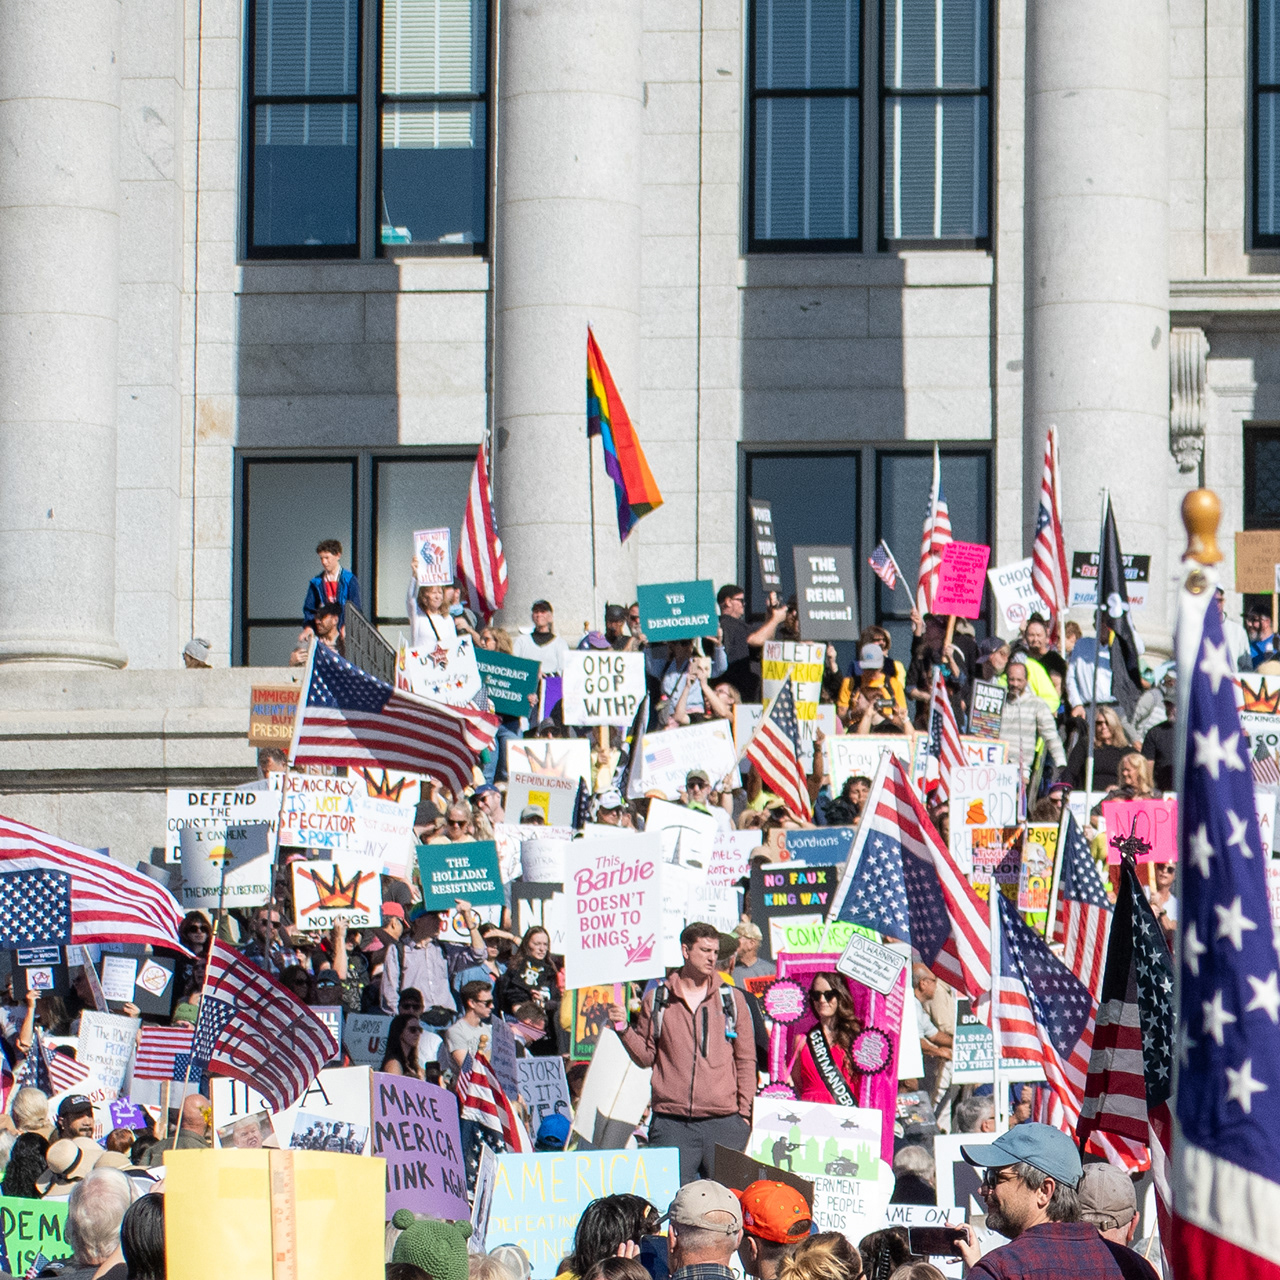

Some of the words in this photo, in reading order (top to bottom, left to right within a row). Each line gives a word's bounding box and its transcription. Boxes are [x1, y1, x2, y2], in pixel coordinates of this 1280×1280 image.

[808, 556, 836, 573] THE
[812, 574, 839, 586] people
[666, 594, 685, 605] YES
[806, 588, 845, 604] REIGN
[648, 614, 710, 630] DEMOCRACY
[583, 656, 625, 675] OMG
[585, 675, 625, 694] GOP
[977, 683, 1006, 701] HANDS
[584, 693, 637, 718] WTH?
[975, 696, 1001, 714] OFF!
[1240, 713, 1254, 723] NO
[515, 774, 573, 790] REPUBLICANS
[955, 771, 997, 794] STOP
[188, 792, 256, 807] DEFEND
[287, 795, 307, 811] IS
[315, 796, 341, 812] NOT
[210, 807, 231, 818] THE
[298, 829, 350, 848] SPORT!
[445, 857, 470, 869] THE
[594, 855, 621, 868] This
[973, 863, 1020, 875] FELON
[432, 868, 489, 883] HOLLADAY
[573, 859, 655, 897] Barbie
[764, 872, 785, 888] NO
[789, 870, 827, 886] FAUX
[431, 880, 496, 896] RESISTANCE
[576, 891, 647, 915] DOESN'T
[764, 891, 797, 907] KING
[800, 891, 828, 906] WAY
[579, 914, 617, 933] BOW
[620, 910, 641, 927] TO
[580, 930, 630, 951] KINGS
[381, 1083, 442, 1123] MAKE
